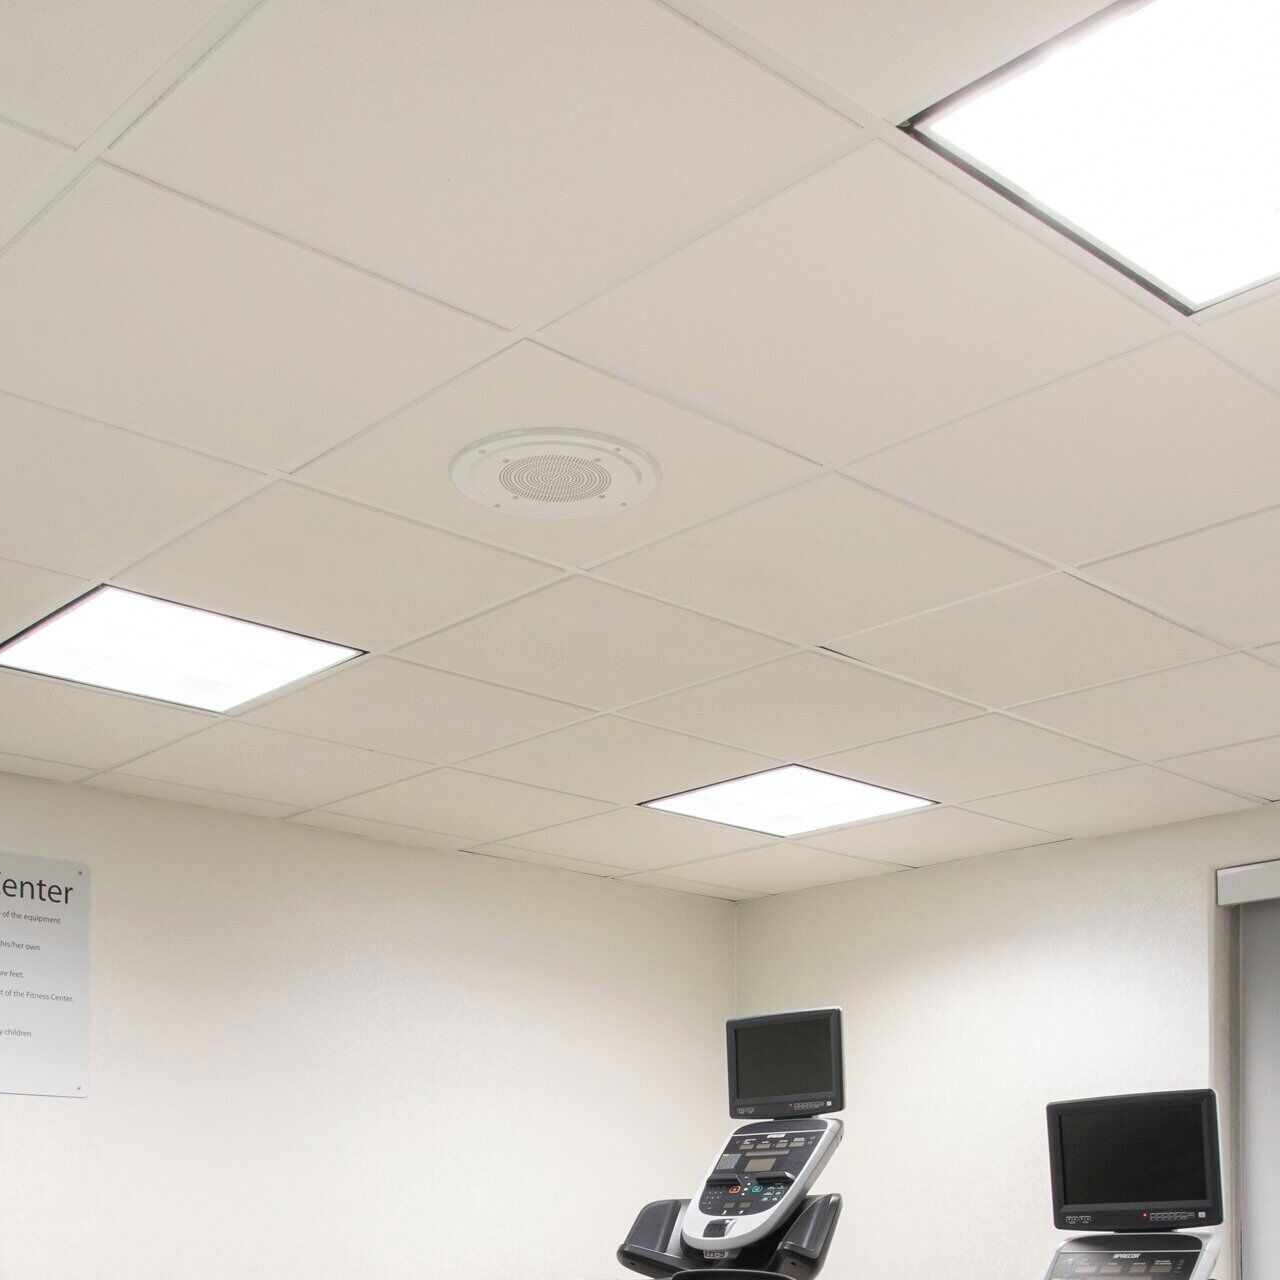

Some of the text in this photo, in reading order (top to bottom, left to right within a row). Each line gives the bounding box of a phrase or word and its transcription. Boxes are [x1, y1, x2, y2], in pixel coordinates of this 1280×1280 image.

[24, 914, 61, 924] equipment
[0, 939, 24, 949] his/her
[14, 990, 25, 998] the
[26, 991, 49, 1000] Fitness
[4, 1028, 31, 1037] children
